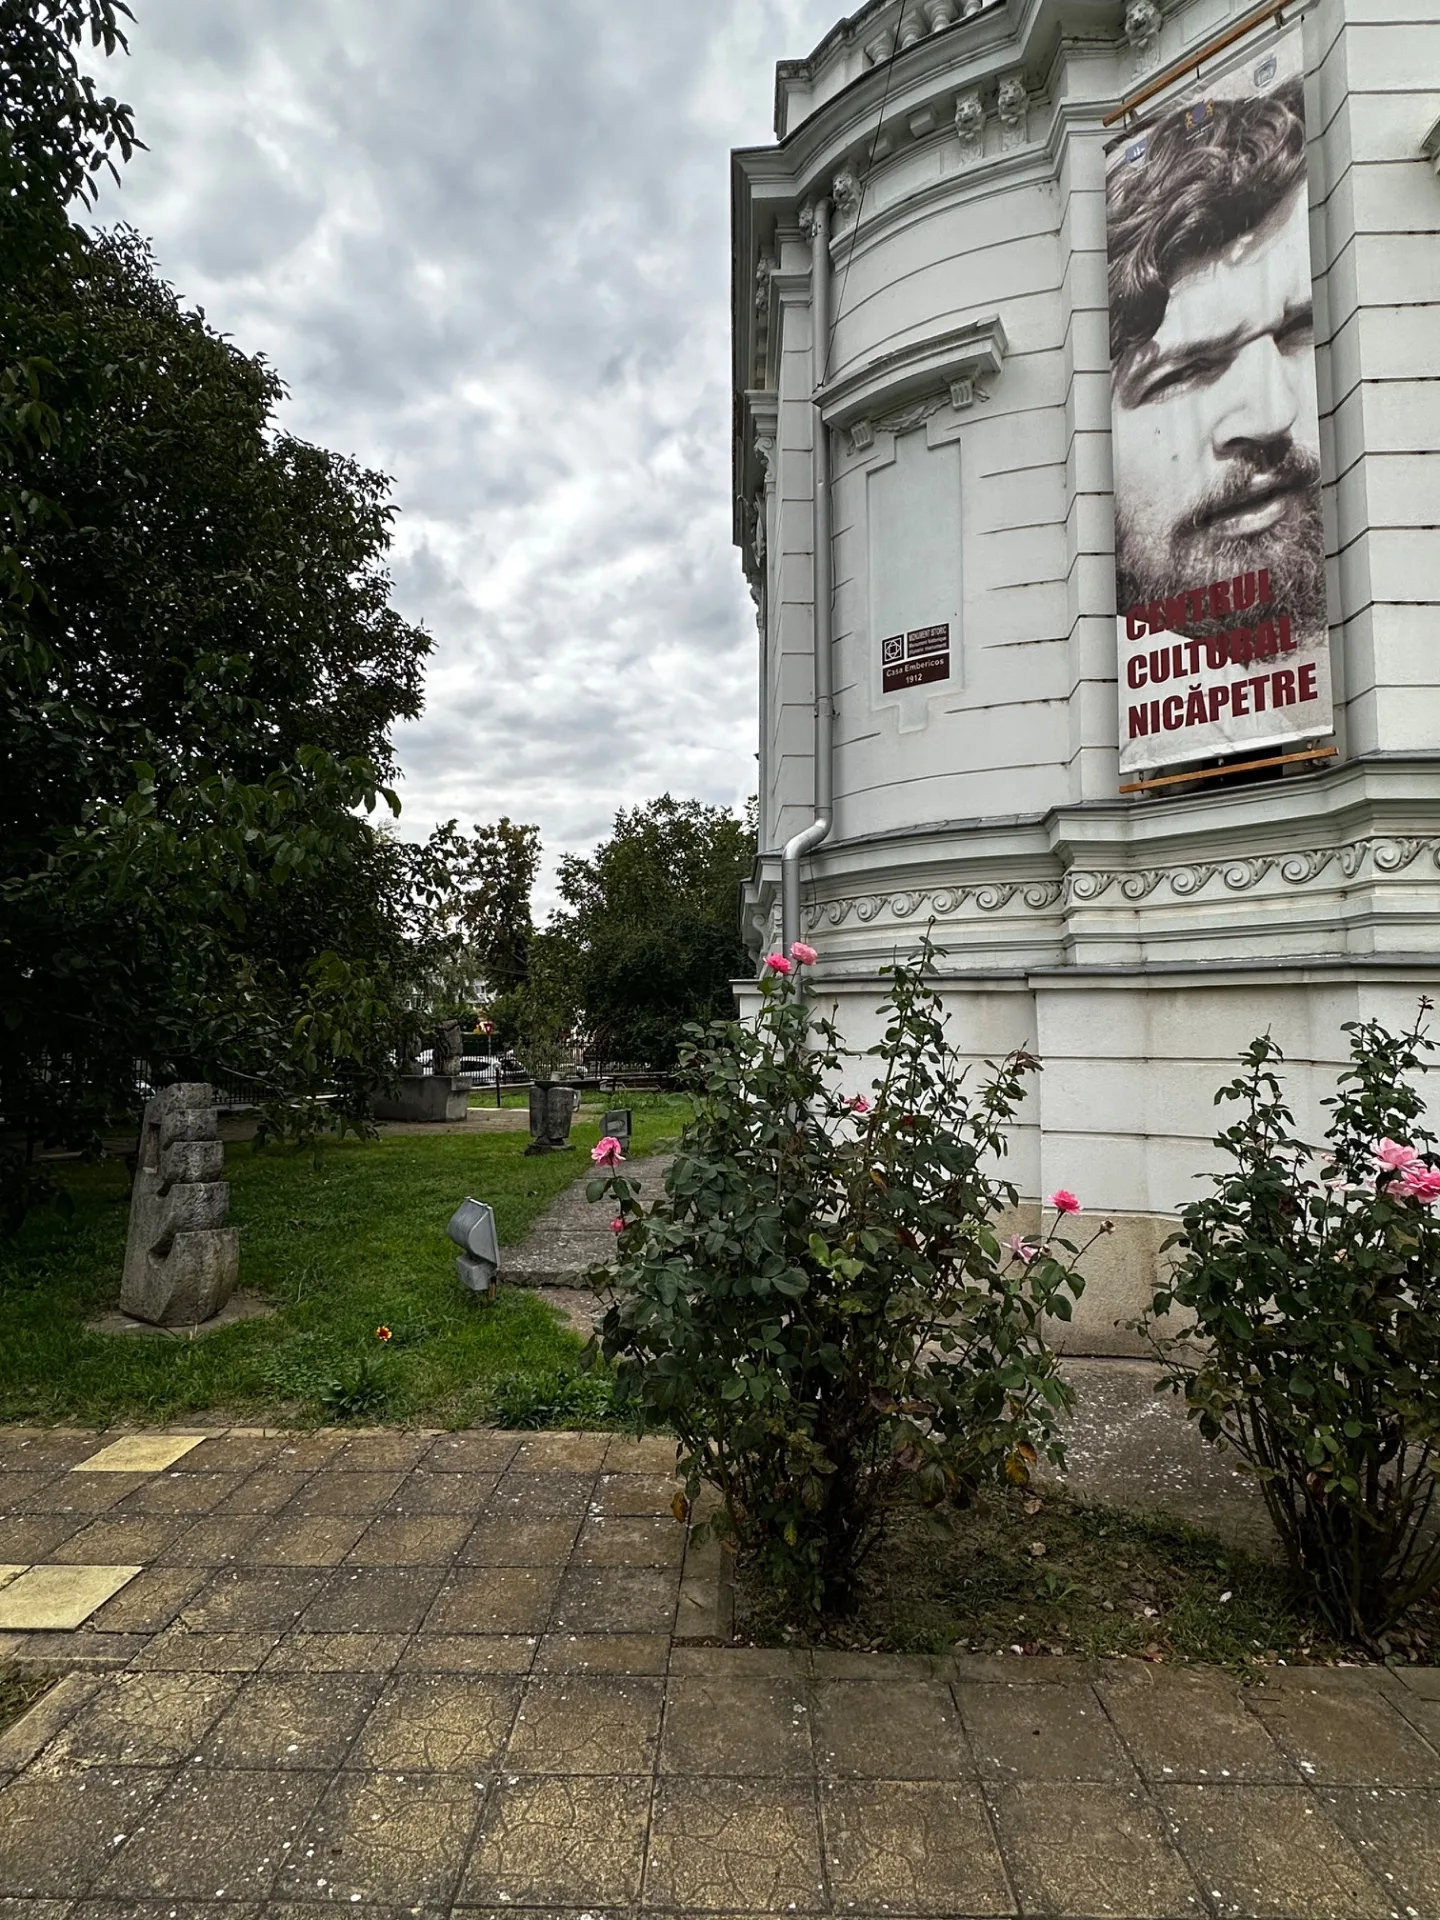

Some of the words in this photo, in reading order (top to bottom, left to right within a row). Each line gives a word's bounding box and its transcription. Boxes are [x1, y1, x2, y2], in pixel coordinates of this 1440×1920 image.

[1126, 568, 1273, 641] CENTRUL
[886, 667, 903, 677] Casa
[904, 658, 945, 672] Embericos
[906, 673, 923, 684] 1912
[1127, 615, 1297, 689] CULTURAL
[1128, 662, 1318, 739] NICĂPETRE
